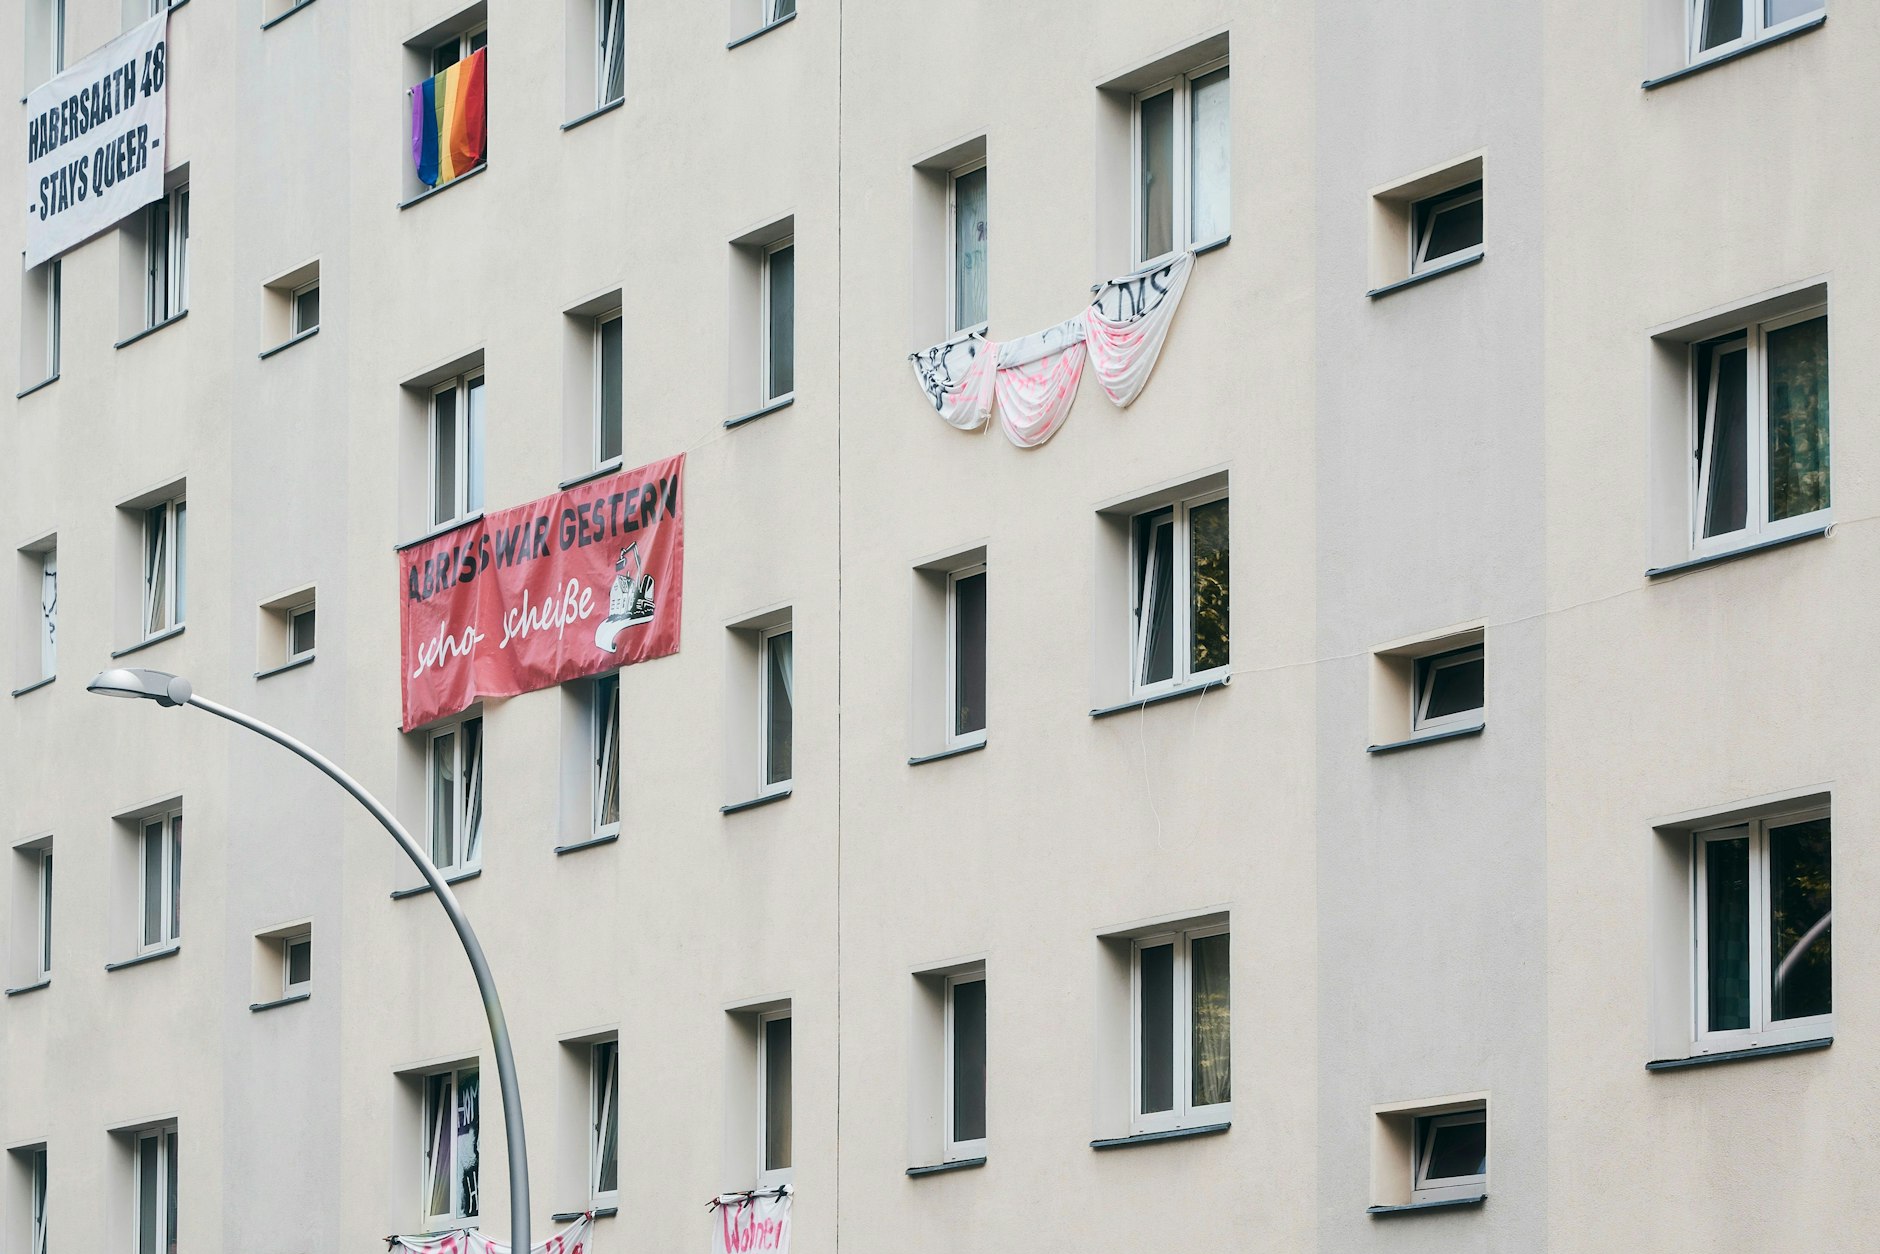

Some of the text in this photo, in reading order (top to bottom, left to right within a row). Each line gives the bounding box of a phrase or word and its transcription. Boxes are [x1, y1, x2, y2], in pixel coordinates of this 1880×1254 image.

[28, 41, 165, 164] HABERSAATH 48
[40, 155, 89, 221] STAYS
[92, 123, 148, 197] QUEER
[408, 474, 678, 603] ABRISS WAR GESTERN
[499, 578, 596, 649] scheiße
